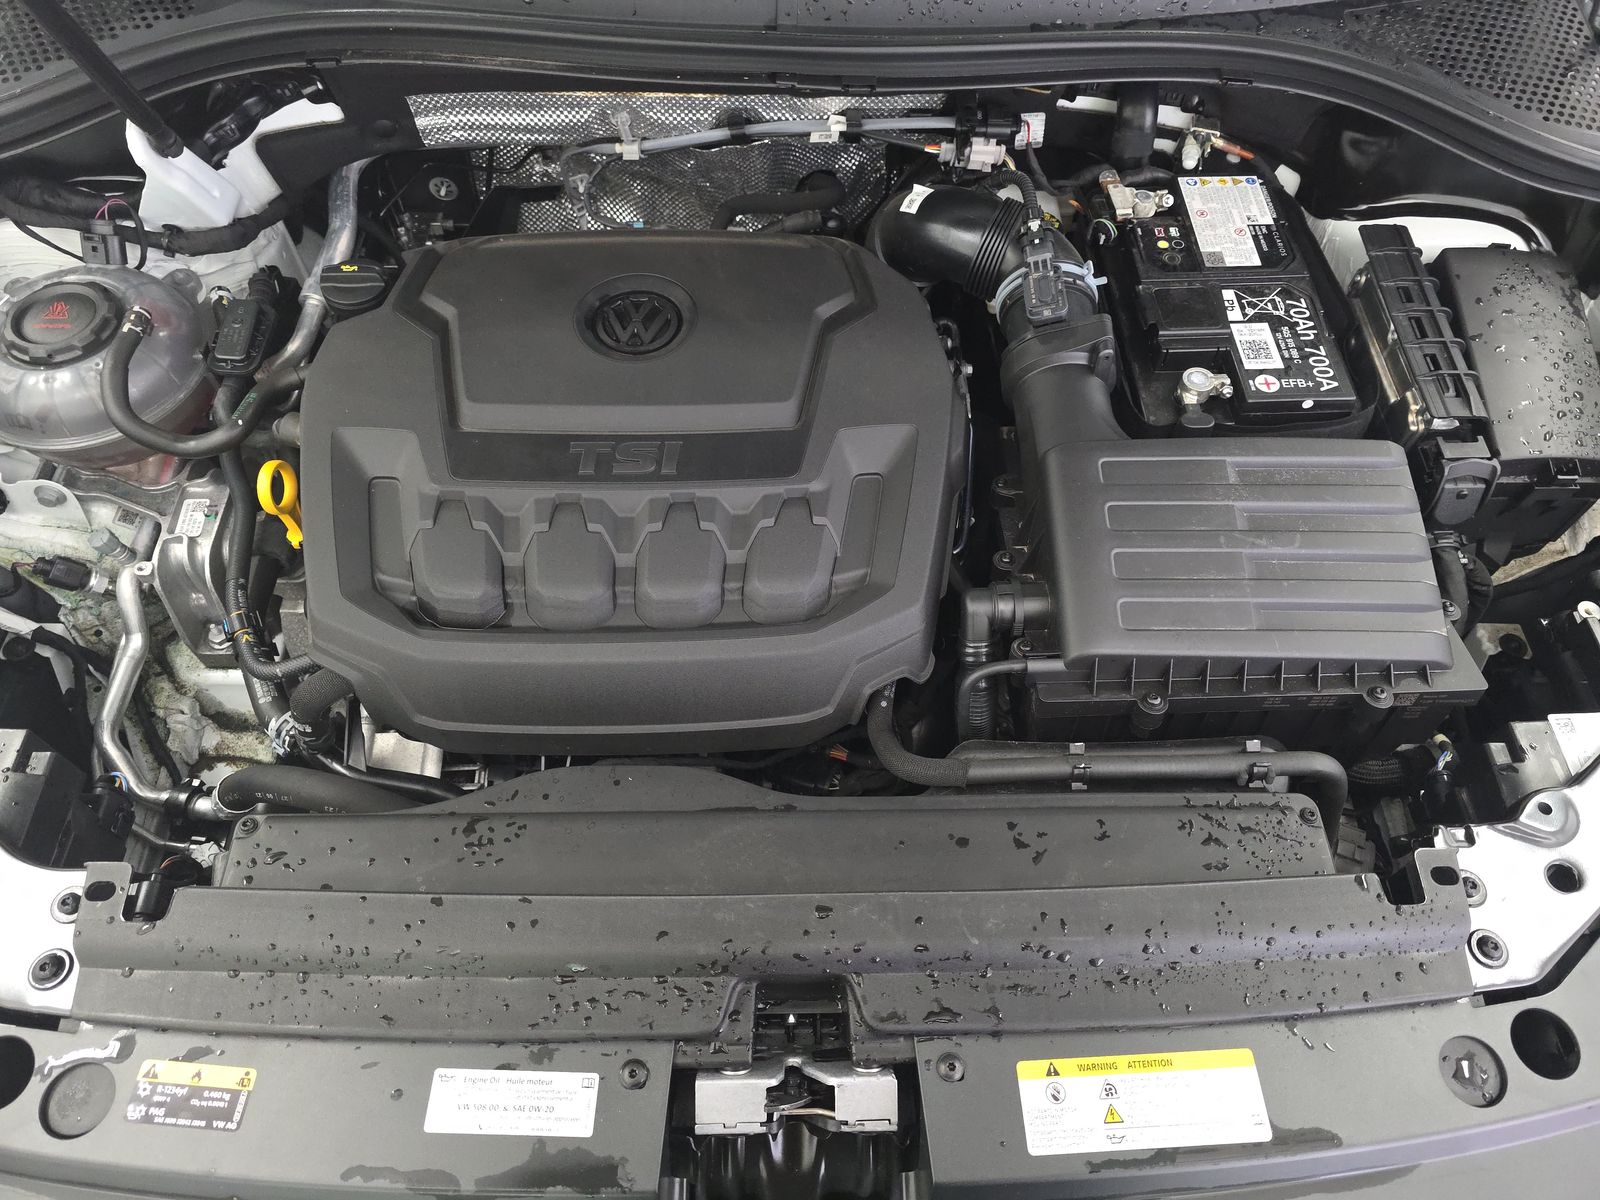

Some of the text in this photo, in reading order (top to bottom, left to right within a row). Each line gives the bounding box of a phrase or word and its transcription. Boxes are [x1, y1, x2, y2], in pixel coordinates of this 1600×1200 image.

[1272, 231, 1287, 257] CLARIOS
[1224, 299, 1236, 312] Pb
[1286, 298, 1339, 391] 70Ah 700A
[1281, 379, 1315, 388] EFB+
[570, 441, 684, 475] TSI
[1077, 1059, 1173, 1072] WARNING ATTENTION
[463, 1076, 489, 1085] Engine
[489, 1076, 500, 1084] Oil
[506, 1077, 525, 1085] Huile
[148, 1106, 166, 1116] PAG
[457, 1103, 470, 1111] VW
[473, 1103, 487, 1111] 508
[512, 1104, 526, 1112] SAE
[528, 1105, 555, 1113] 0W-20
